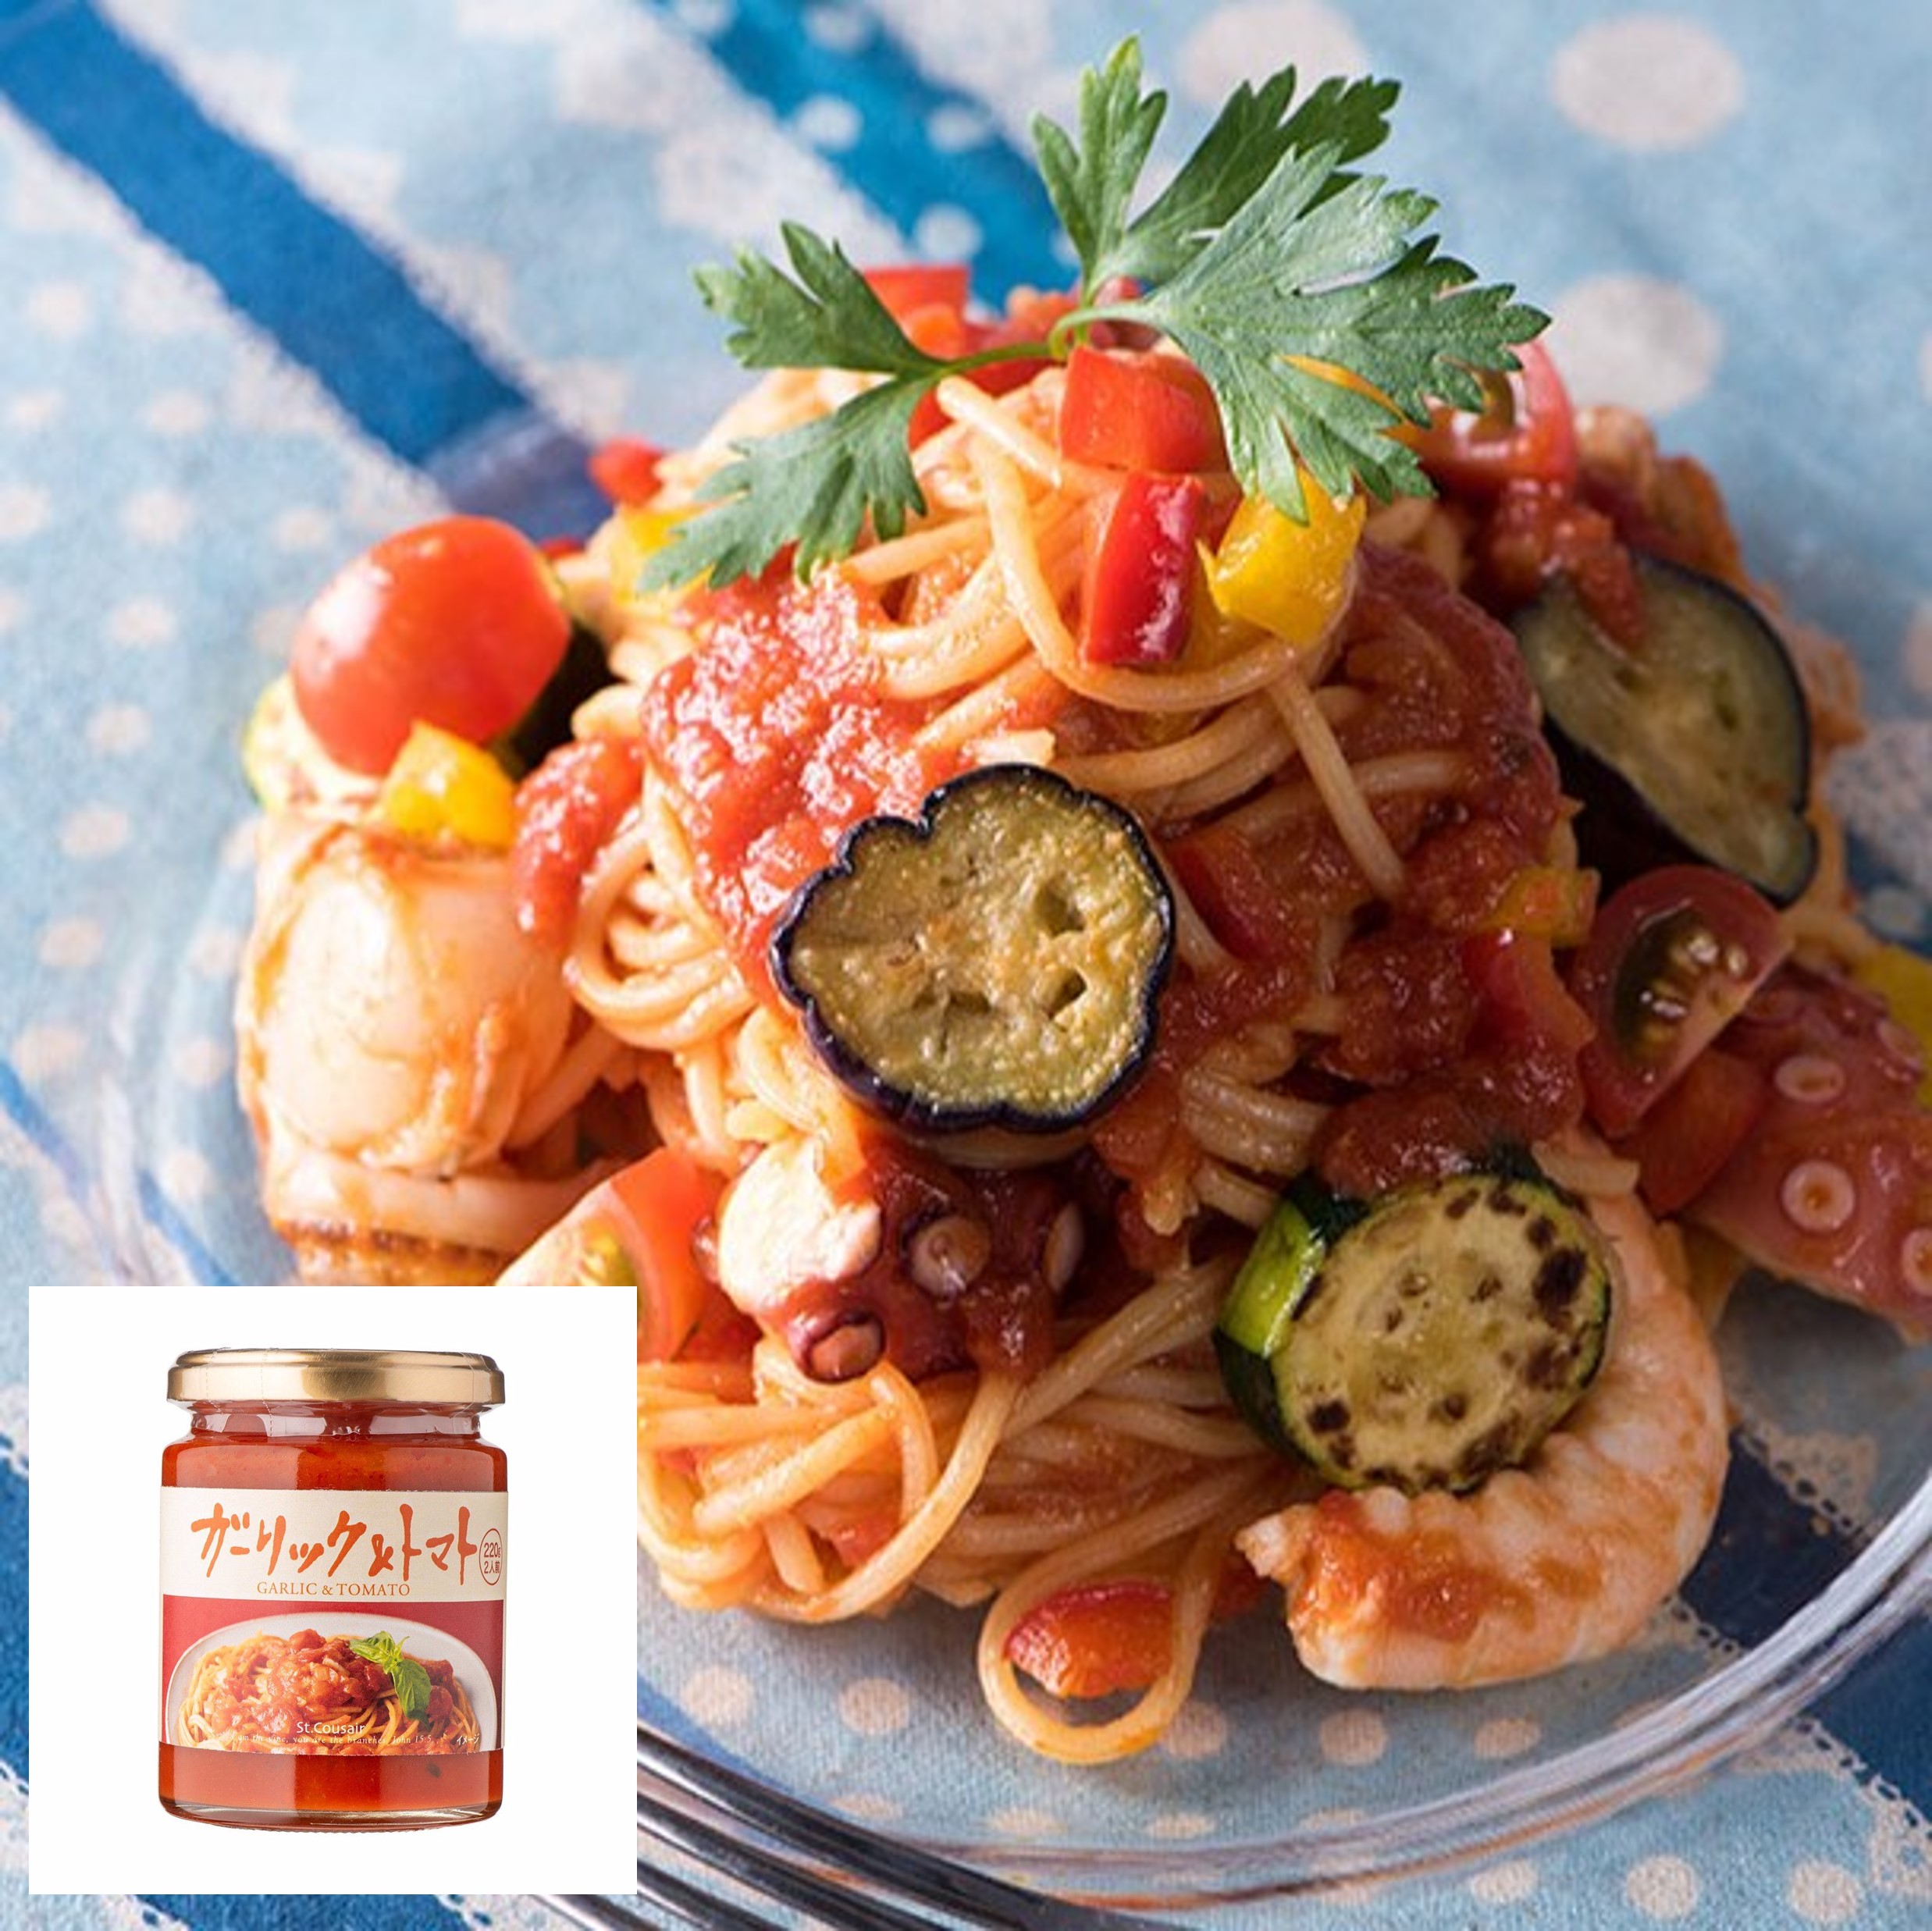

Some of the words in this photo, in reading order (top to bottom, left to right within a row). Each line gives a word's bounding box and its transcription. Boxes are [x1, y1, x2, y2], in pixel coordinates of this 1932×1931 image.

[484, 1542, 500, 1558] 220g
[257, 1581, 317, 1595] GARLIC
[322, 1584, 333, 1595] &
[336, 1583, 410, 1596] TOMATO
[297, 1722, 365, 1734] St.Cousair
[457, 1733, 479, 1745] イメージ
